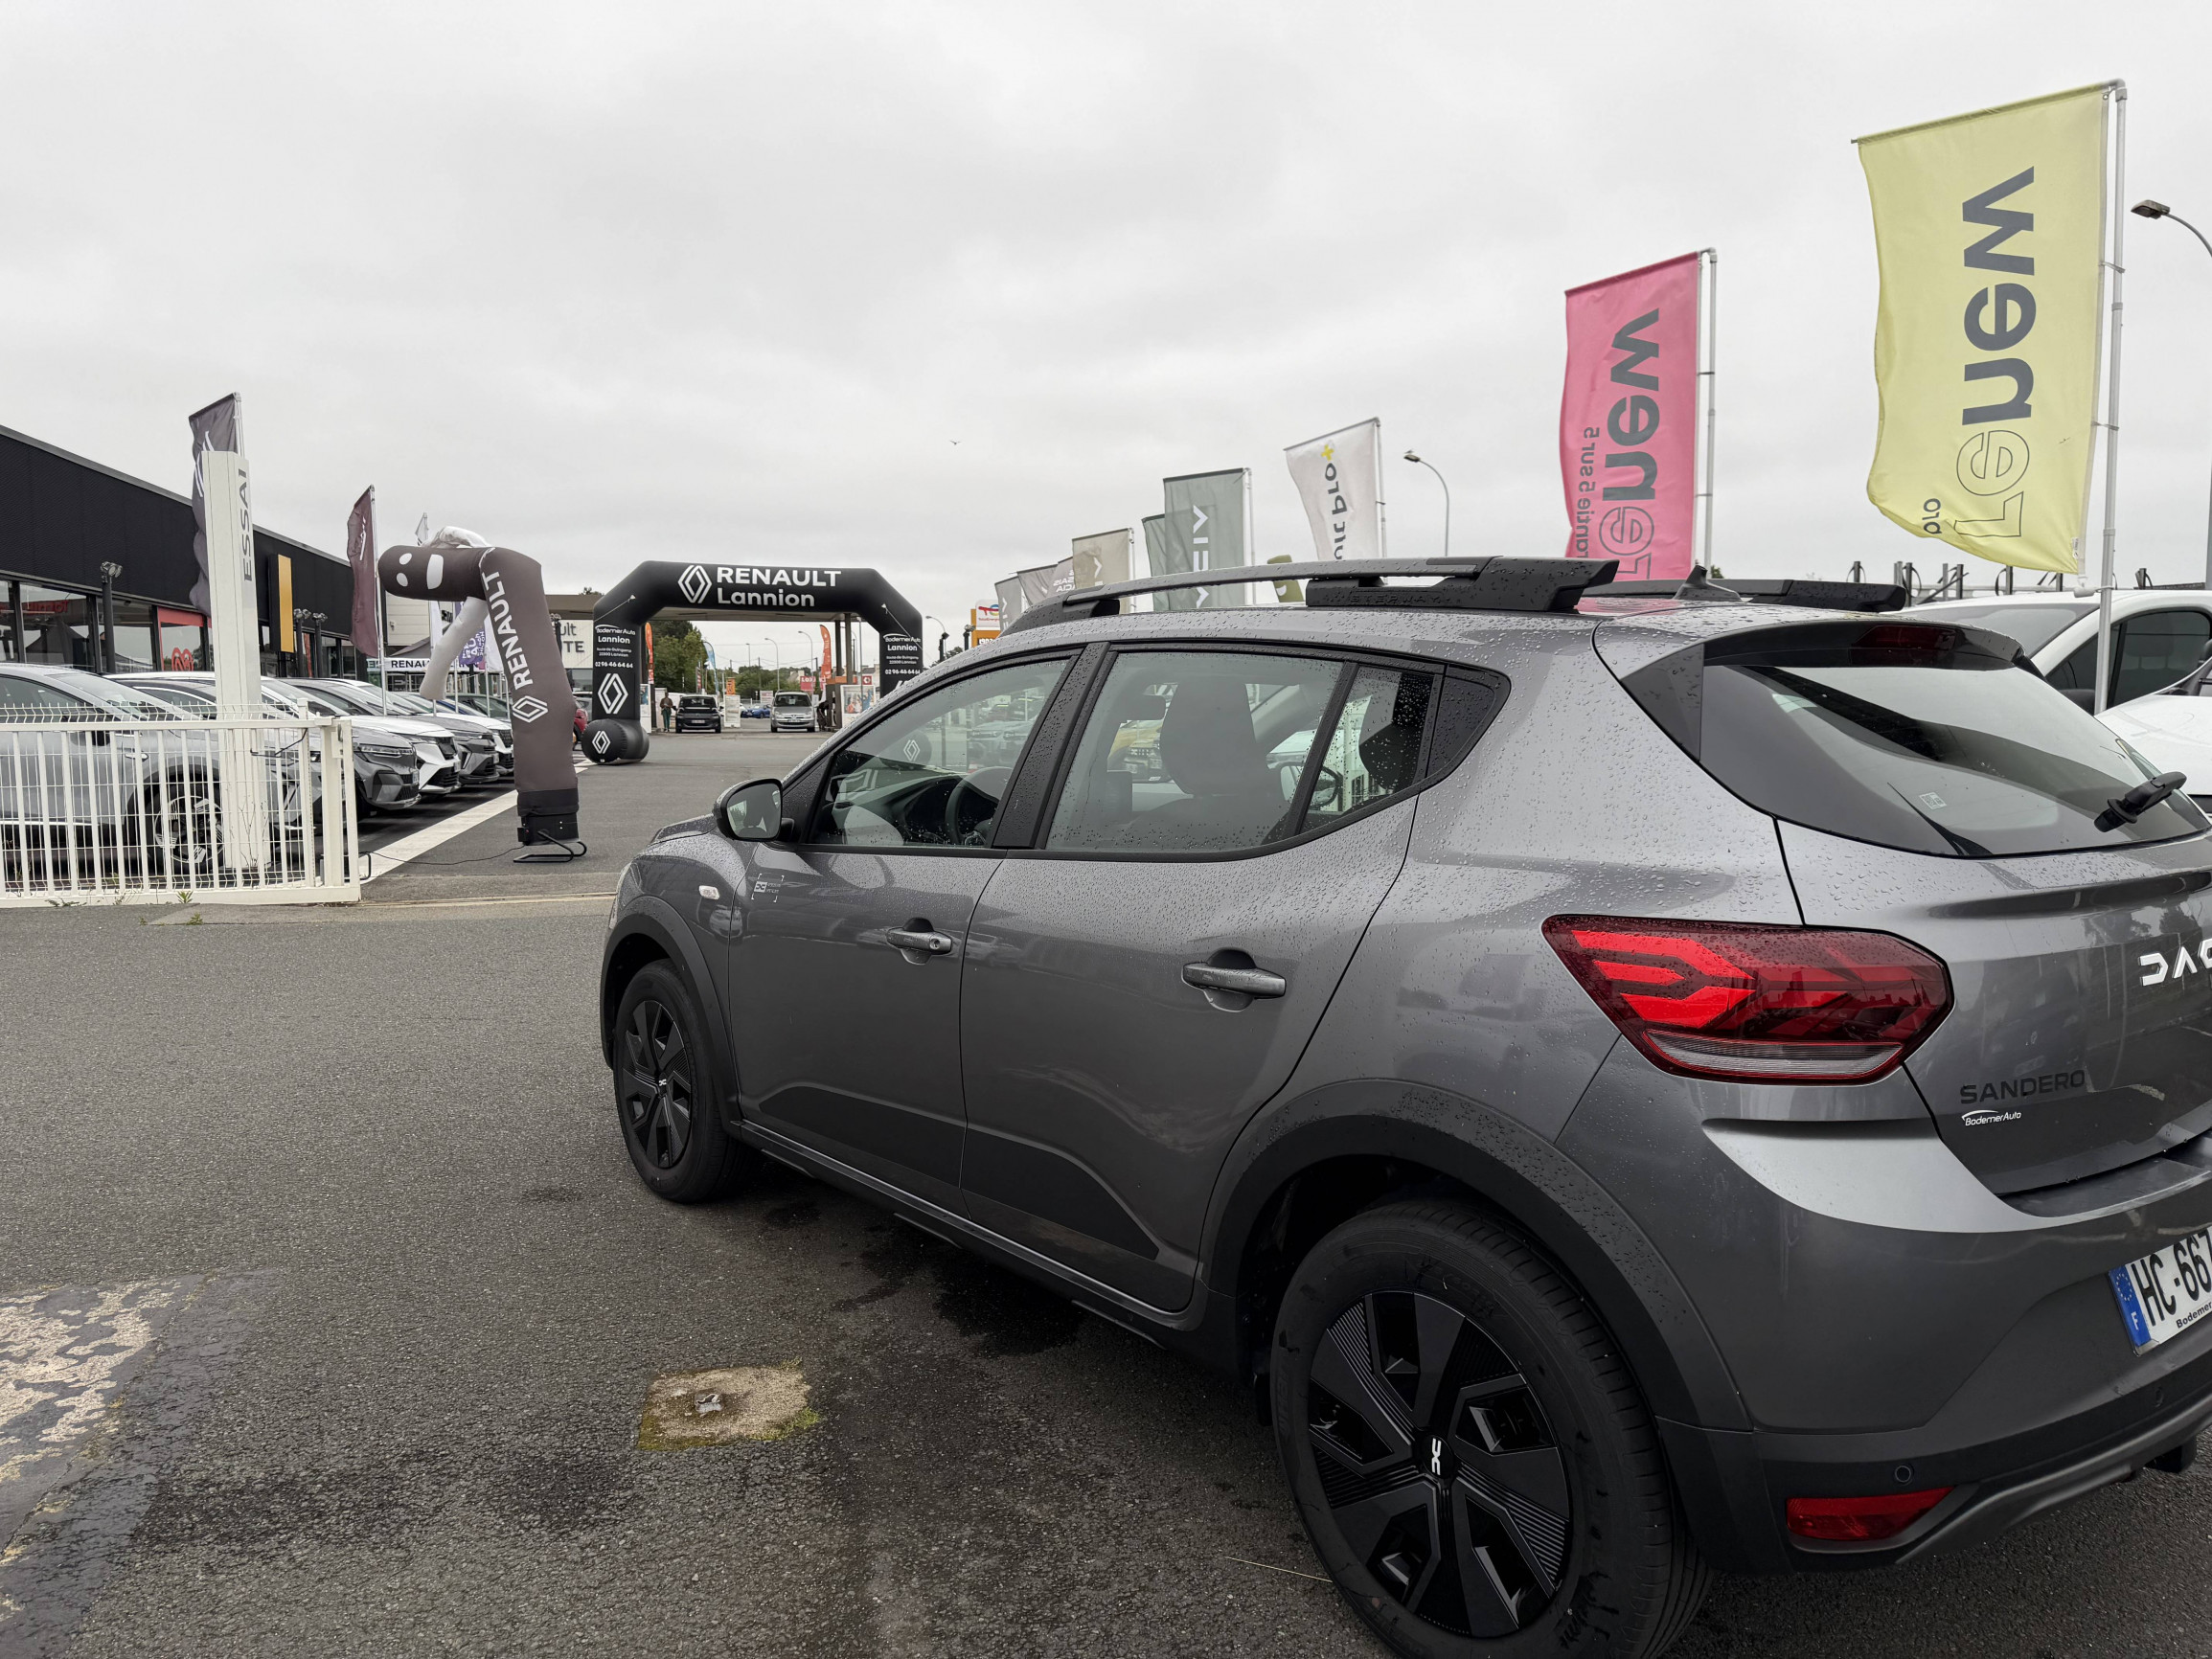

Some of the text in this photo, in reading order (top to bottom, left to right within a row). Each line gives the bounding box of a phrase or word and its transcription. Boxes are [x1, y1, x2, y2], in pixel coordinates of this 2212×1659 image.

[238, 467, 253, 582] ESSAI
[717, 566, 842, 587] RENAULT
[717, 587, 815, 607] Lannion
[1350, 594, 1441, 604] STEPWAY
[481, 571, 534, 691] RENAULT
[562, 640, 585, 653] TE
[1959, 1069, 2086, 1104] SANDERO
[1962, 1110, 2022, 1126] BodemerAuto
[2131, 1310, 2139, 1330] F
